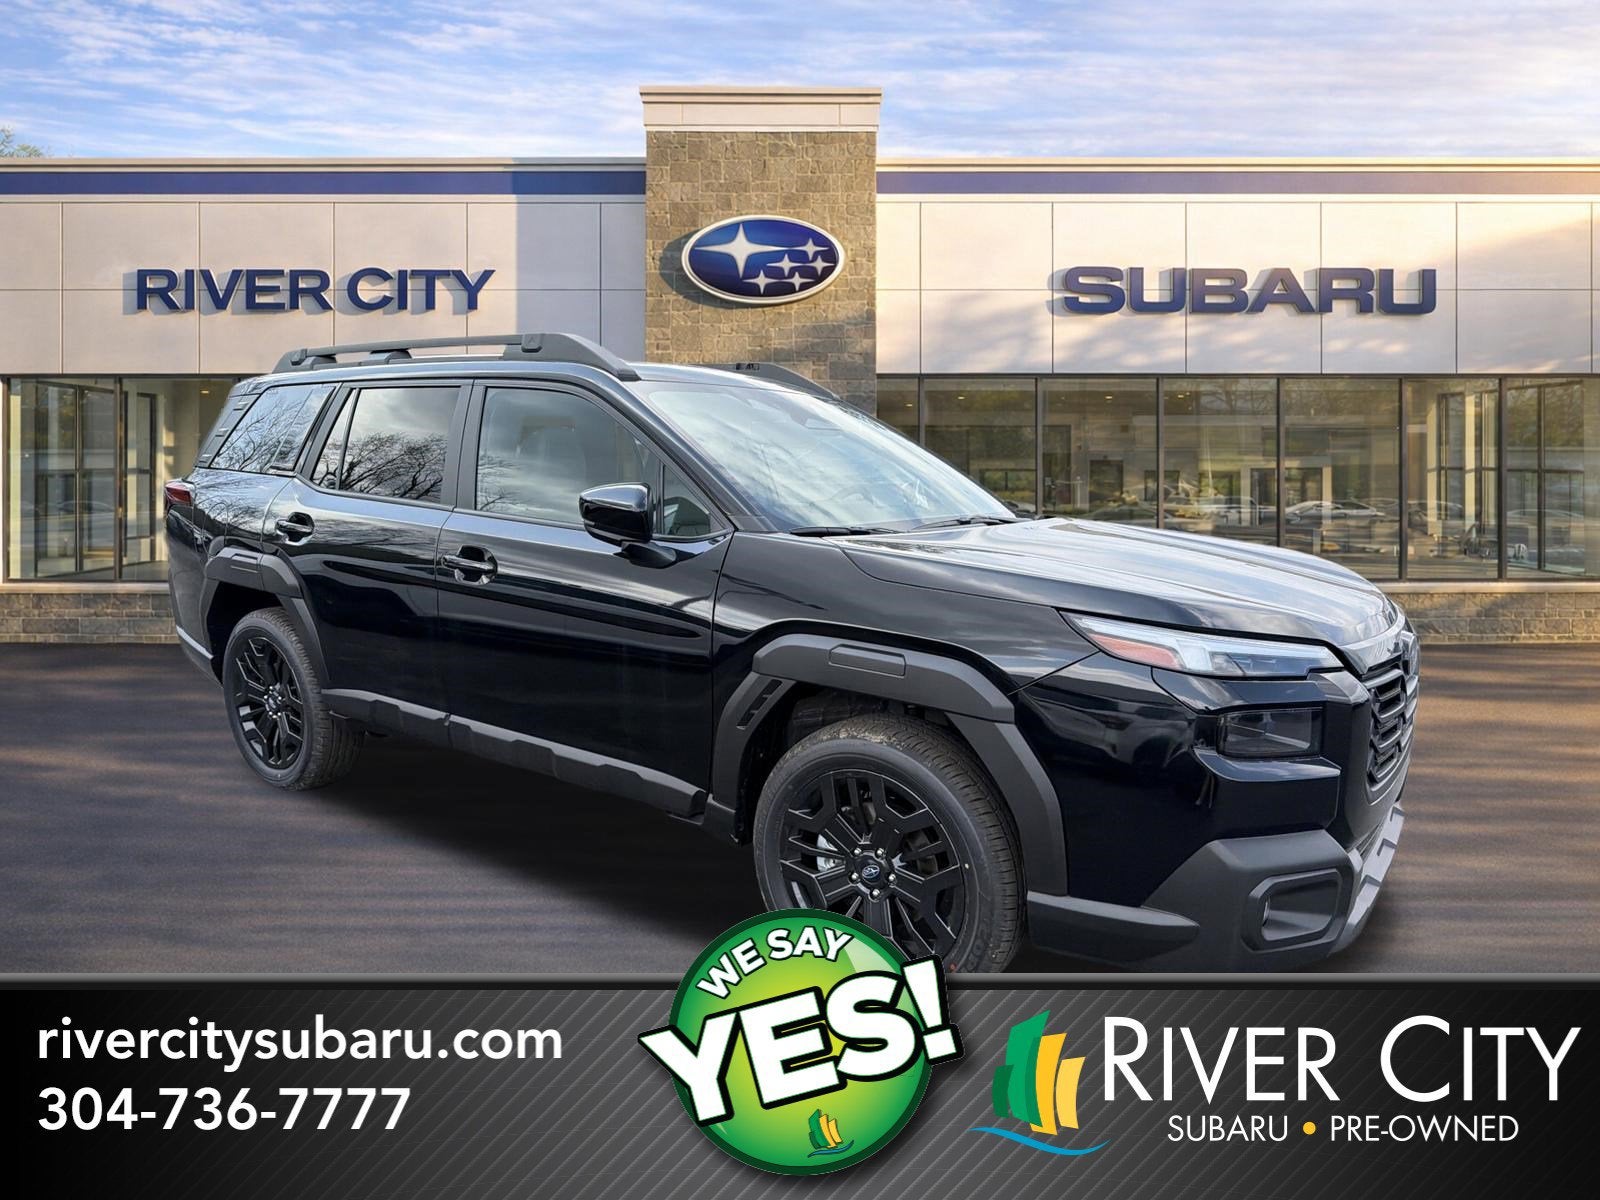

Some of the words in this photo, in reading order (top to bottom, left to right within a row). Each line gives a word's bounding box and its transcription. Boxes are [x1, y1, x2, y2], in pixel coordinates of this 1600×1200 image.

[136, 269, 334, 310] RIVER
[347, 267, 496, 310] CITY
[1063, 266, 1437, 315] SUBARU
